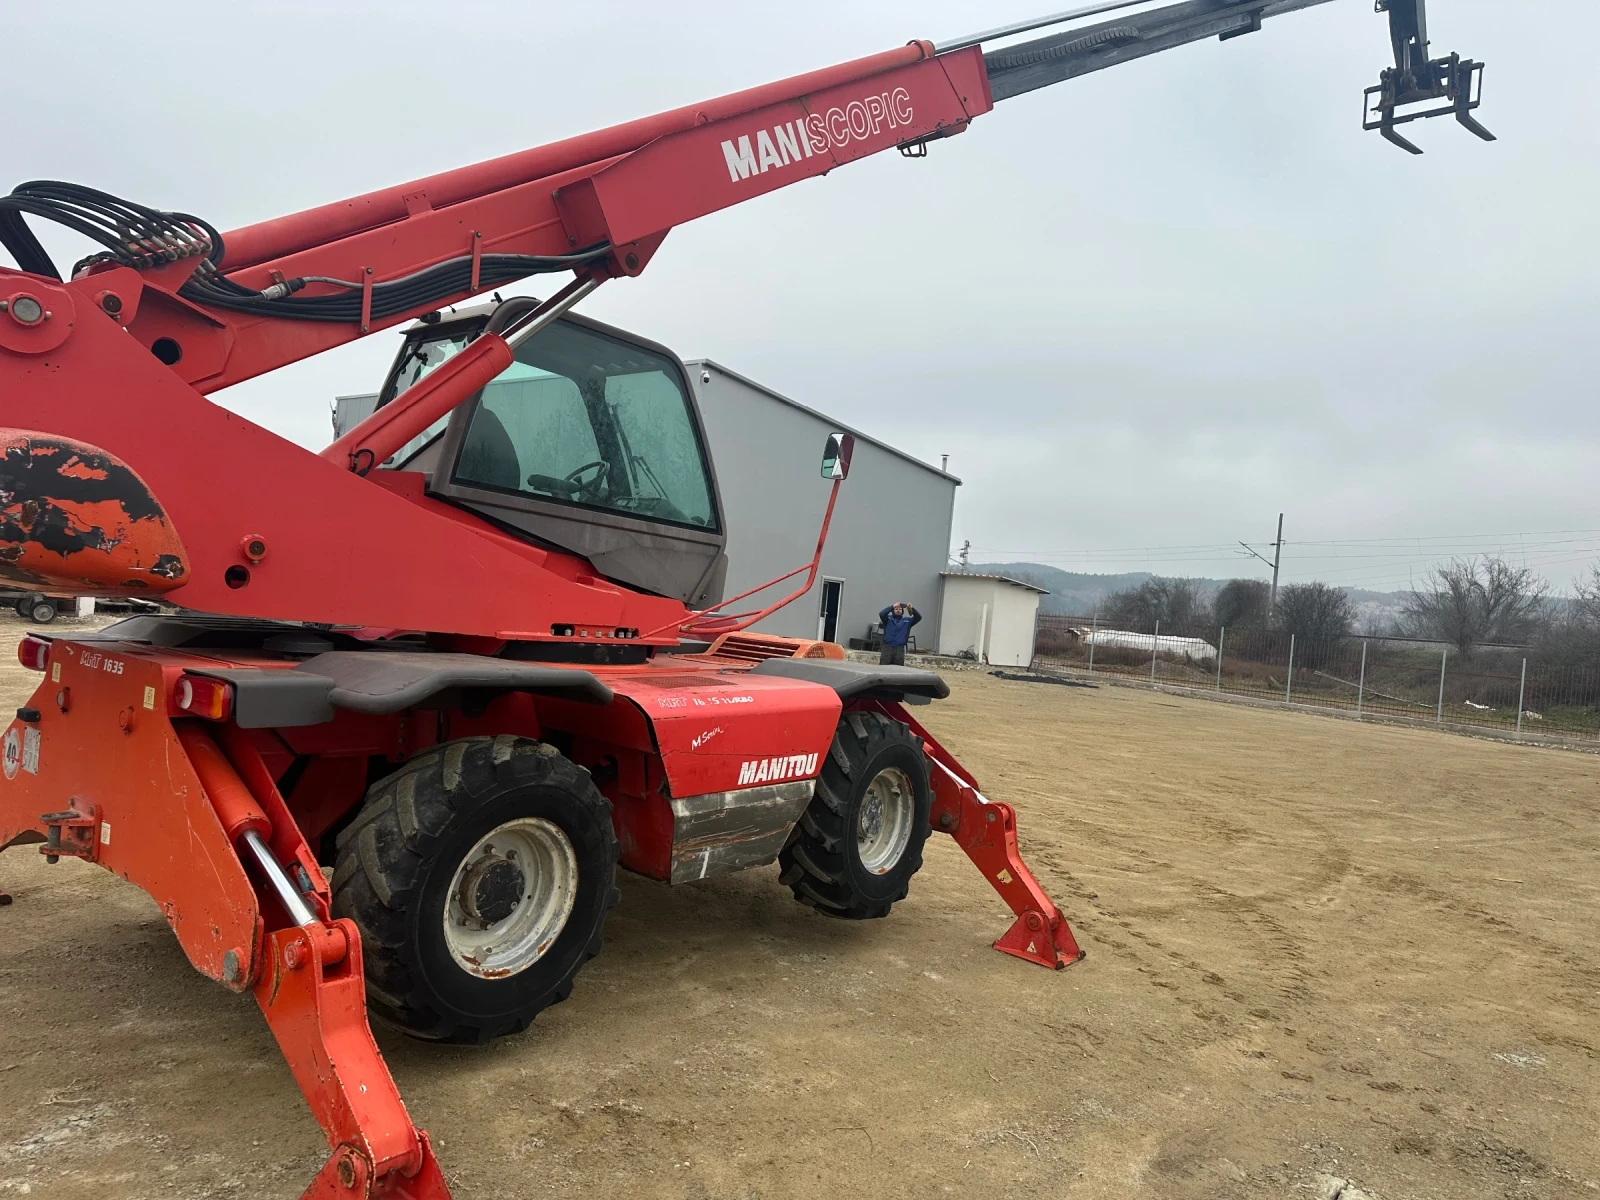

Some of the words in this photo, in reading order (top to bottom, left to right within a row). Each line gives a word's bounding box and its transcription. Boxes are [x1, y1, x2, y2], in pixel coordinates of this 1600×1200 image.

[720, 87, 914, 183] MANISCOPIC
[80, 651, 102, 668] MRT
[103, 658, 124, 675] 1635
[737, 753, 819, 785] MANITOU
